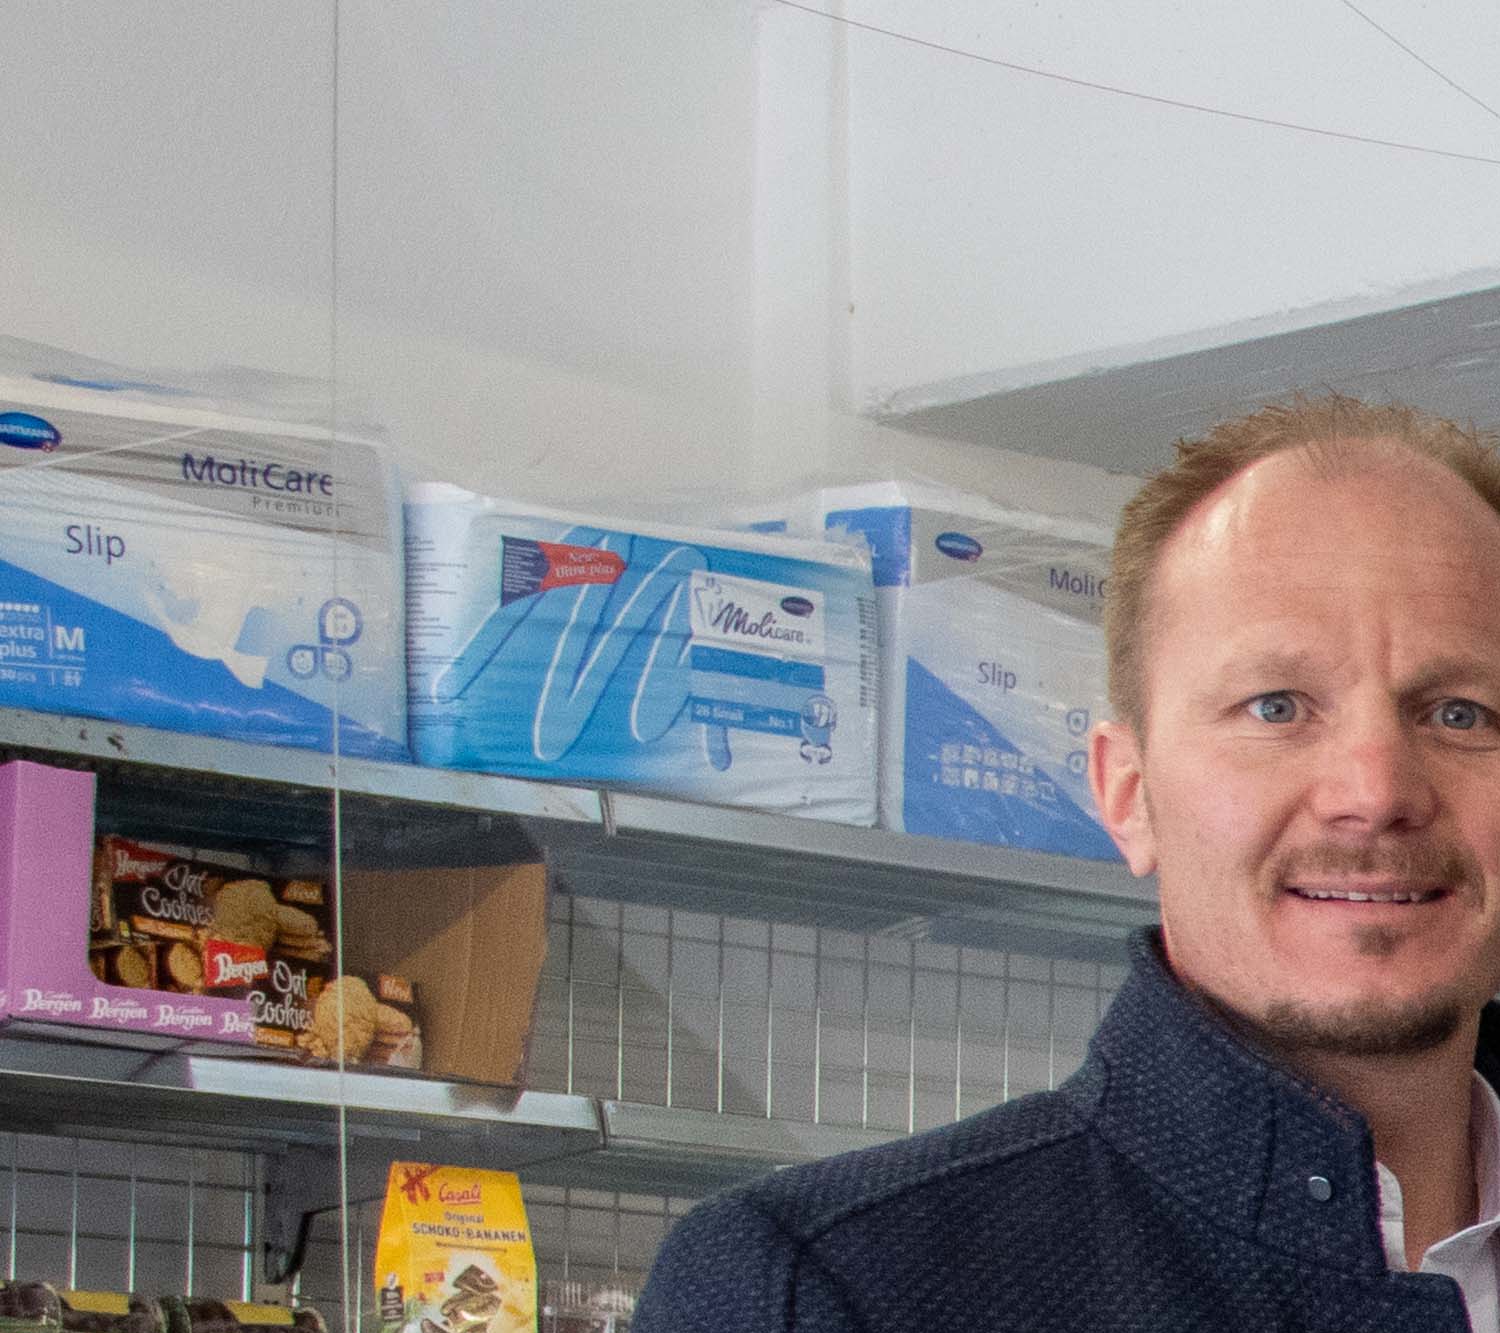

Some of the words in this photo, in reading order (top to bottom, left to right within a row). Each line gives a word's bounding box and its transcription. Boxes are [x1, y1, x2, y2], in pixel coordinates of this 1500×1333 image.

[65, 524, 127, 565] Slip
[54, 625, 86, 652] M
[977, 660, 1017, 691] Slip
[141, 888, 216, 927] Cookies
[213, 953, 268, 983] Bergen
[272, 961, 308, 1001] Oat
[247, 991, 315, 1031] Cookies
[438, 1182, 482, 1204] Casali
[411, 1222, 527, 1243] SCHOKO-BANANEN
[444, 1210, 485, 1225] Original
